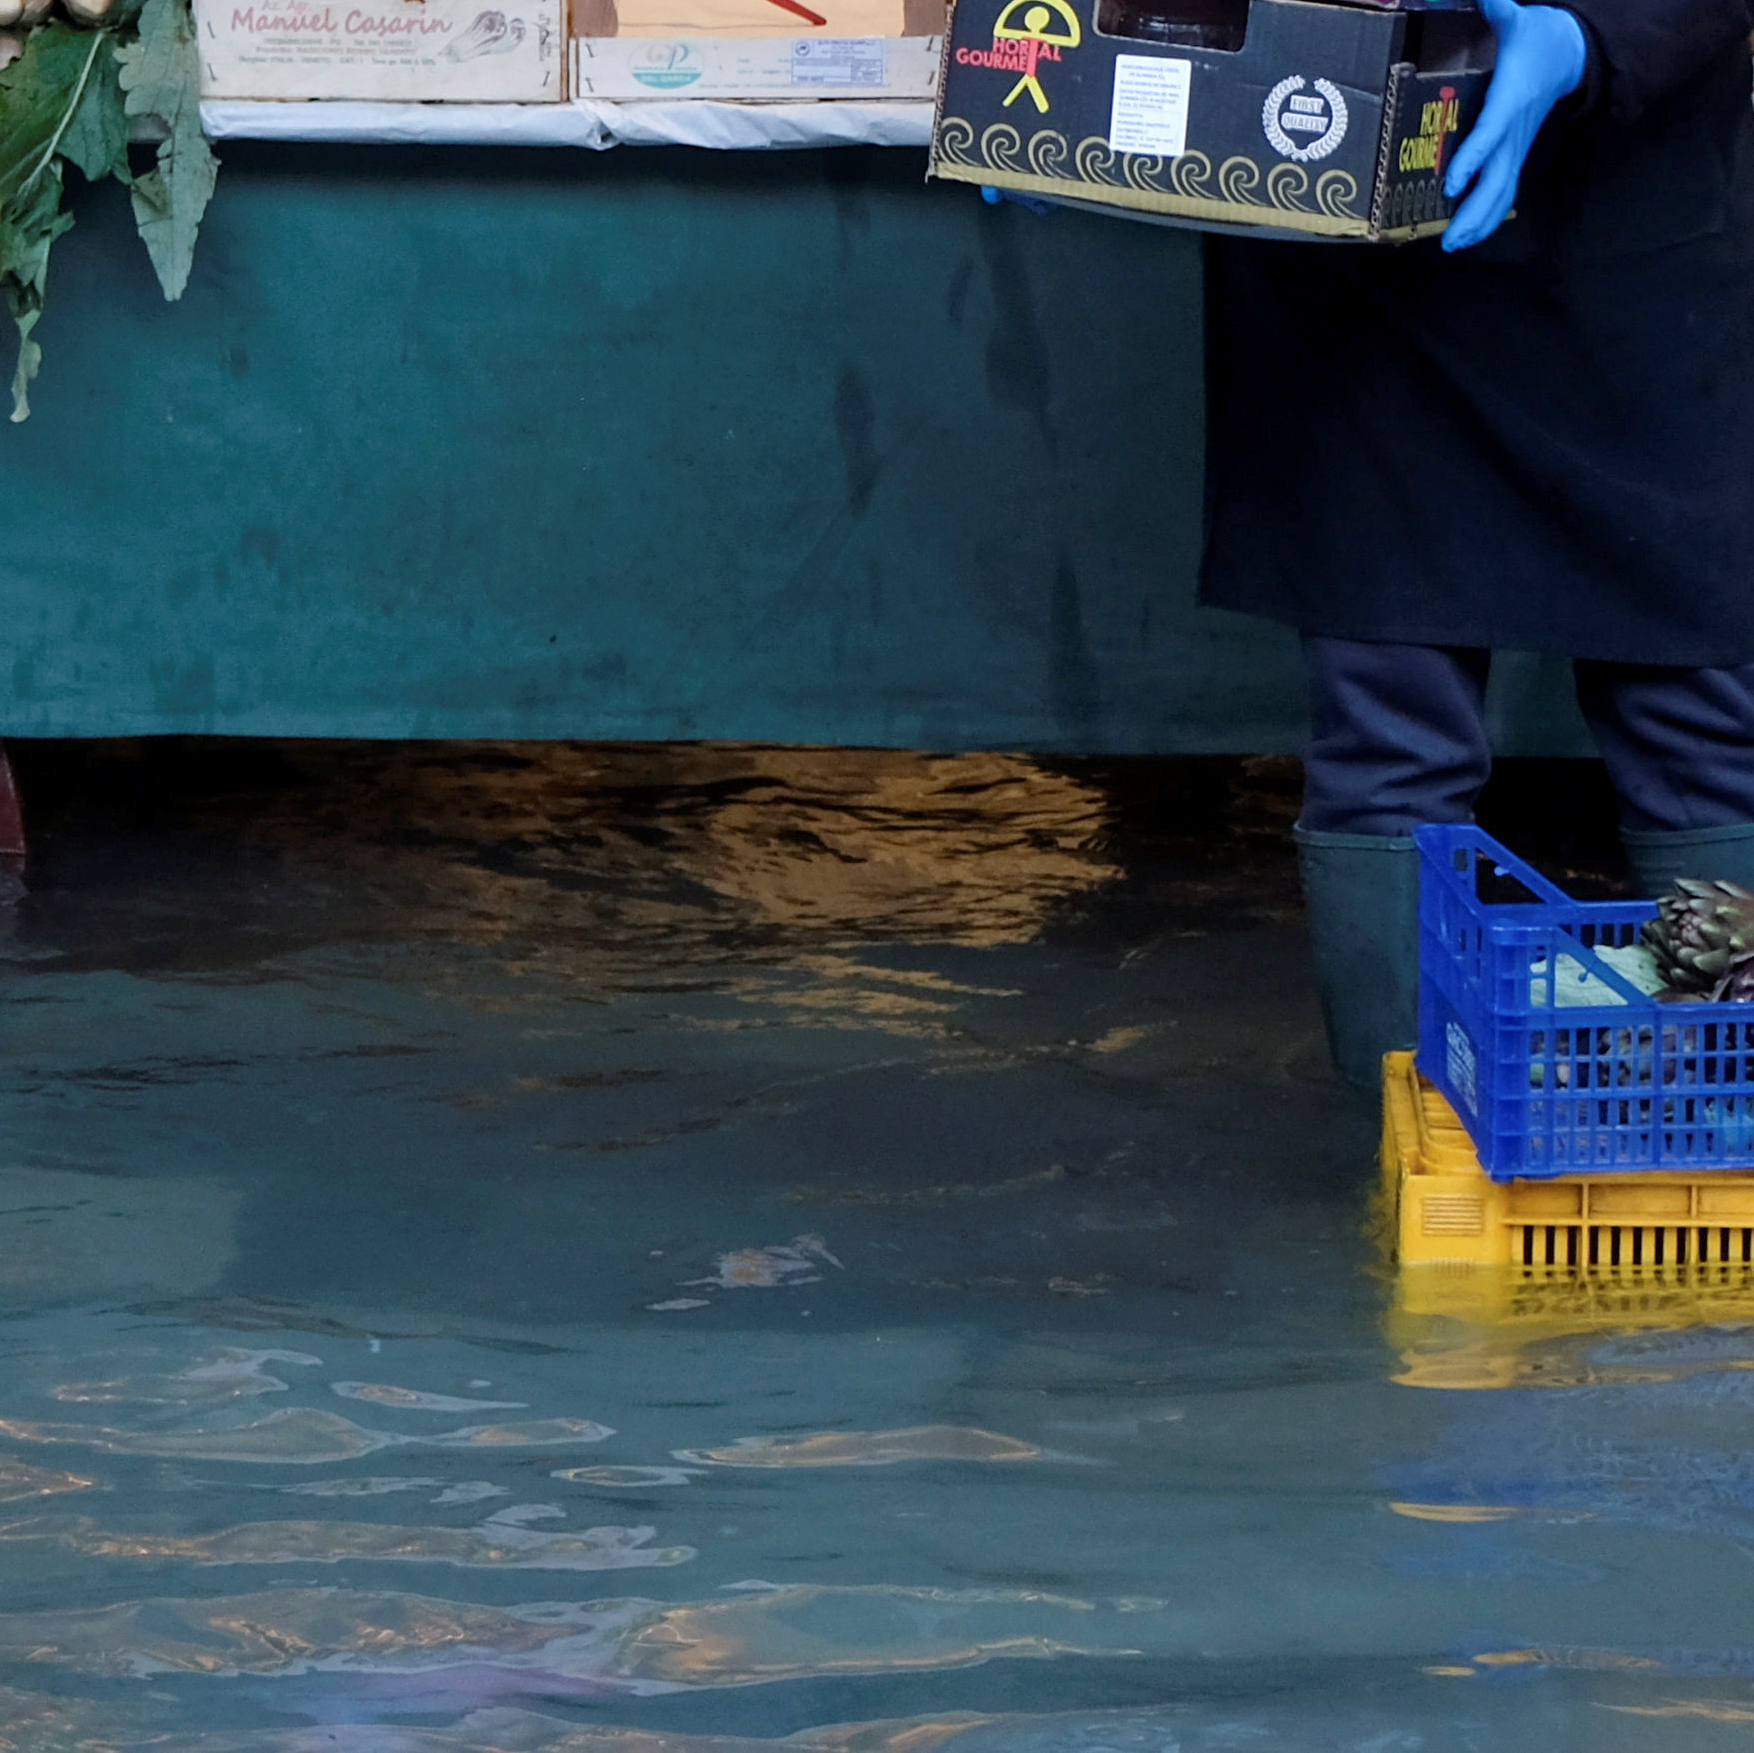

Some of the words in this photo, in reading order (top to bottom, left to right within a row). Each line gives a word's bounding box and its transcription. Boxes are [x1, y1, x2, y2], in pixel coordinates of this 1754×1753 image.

[231, 6, 340, 34] Manuel
[344, 6, 454, 38] Casarin
[1289, 94, 1325, 115] FIRST
[1279, 113, 1328, 133] QUALITY
